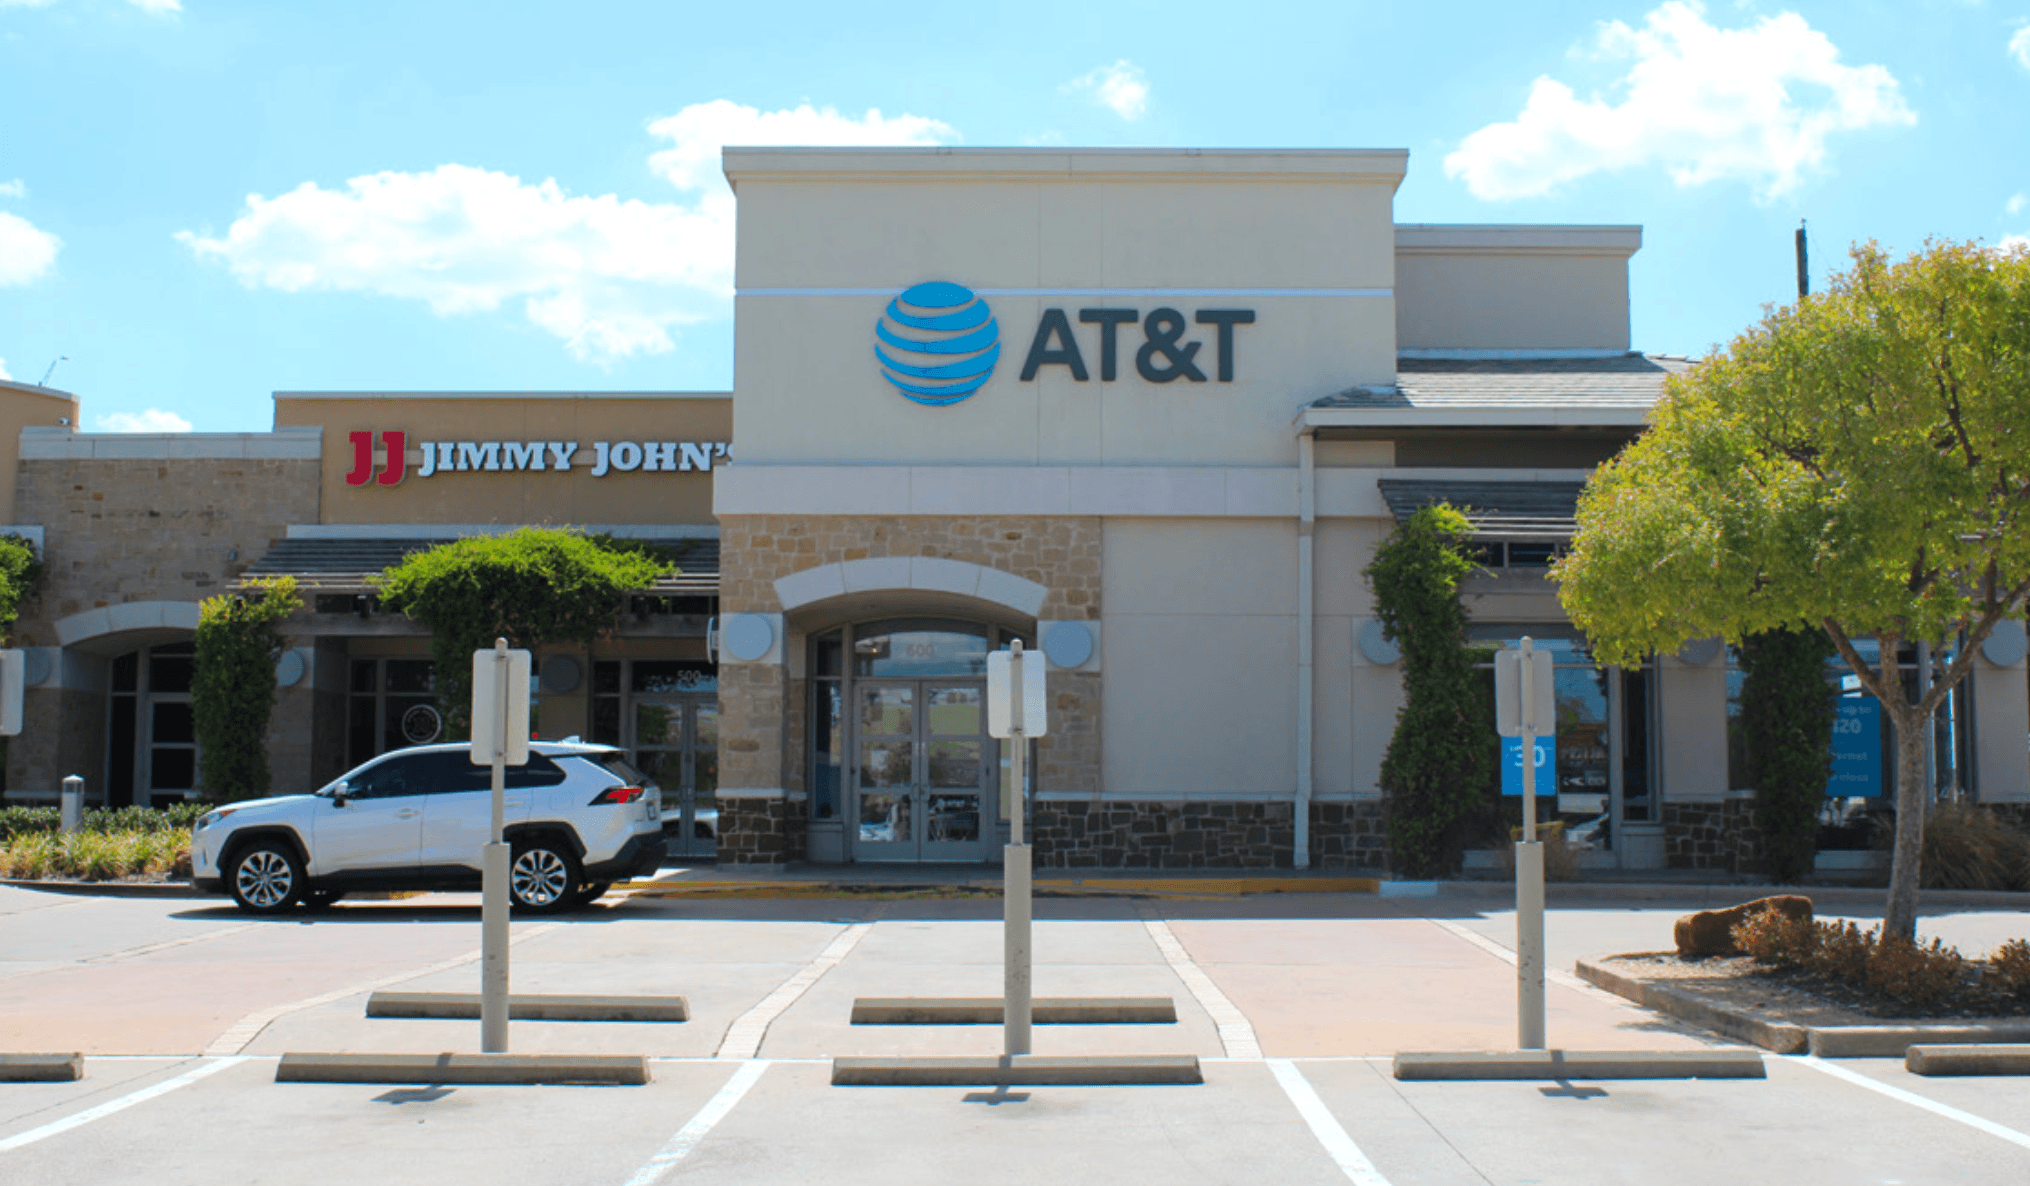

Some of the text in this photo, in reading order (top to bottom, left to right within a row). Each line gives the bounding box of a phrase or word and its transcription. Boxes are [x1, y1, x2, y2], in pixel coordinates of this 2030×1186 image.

[1019, 308, 1255, 384] AT&T
[345, 431, 405, 486] JJ
[418, 441, 578, 477] JIMMY
